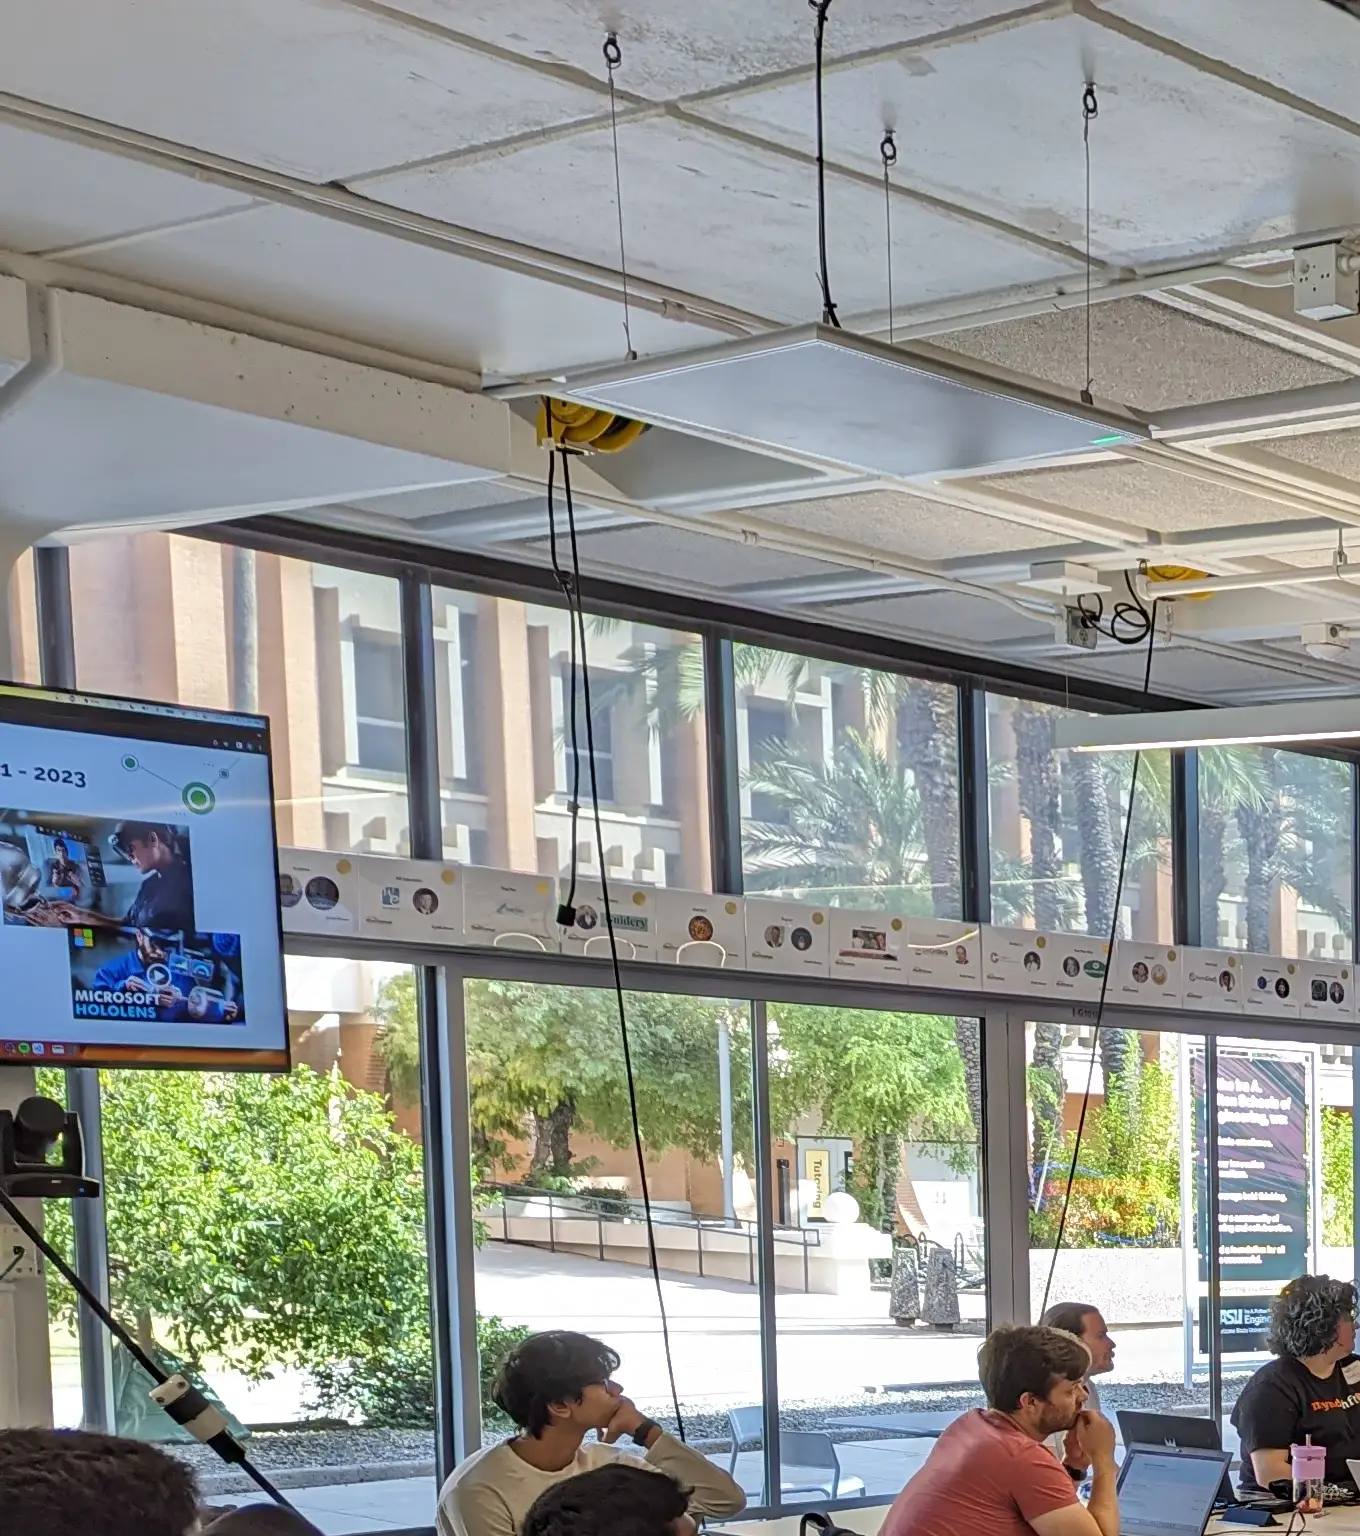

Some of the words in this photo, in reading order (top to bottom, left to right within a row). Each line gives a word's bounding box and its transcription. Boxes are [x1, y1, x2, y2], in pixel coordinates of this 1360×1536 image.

[34, 766, 86, 788] 2023
[75, 989, 160, 1005] MICROSOFT
[76, 1003, 156, 1018] HOLOLENS
[1244, 1315, 1272, 1326] Engine
